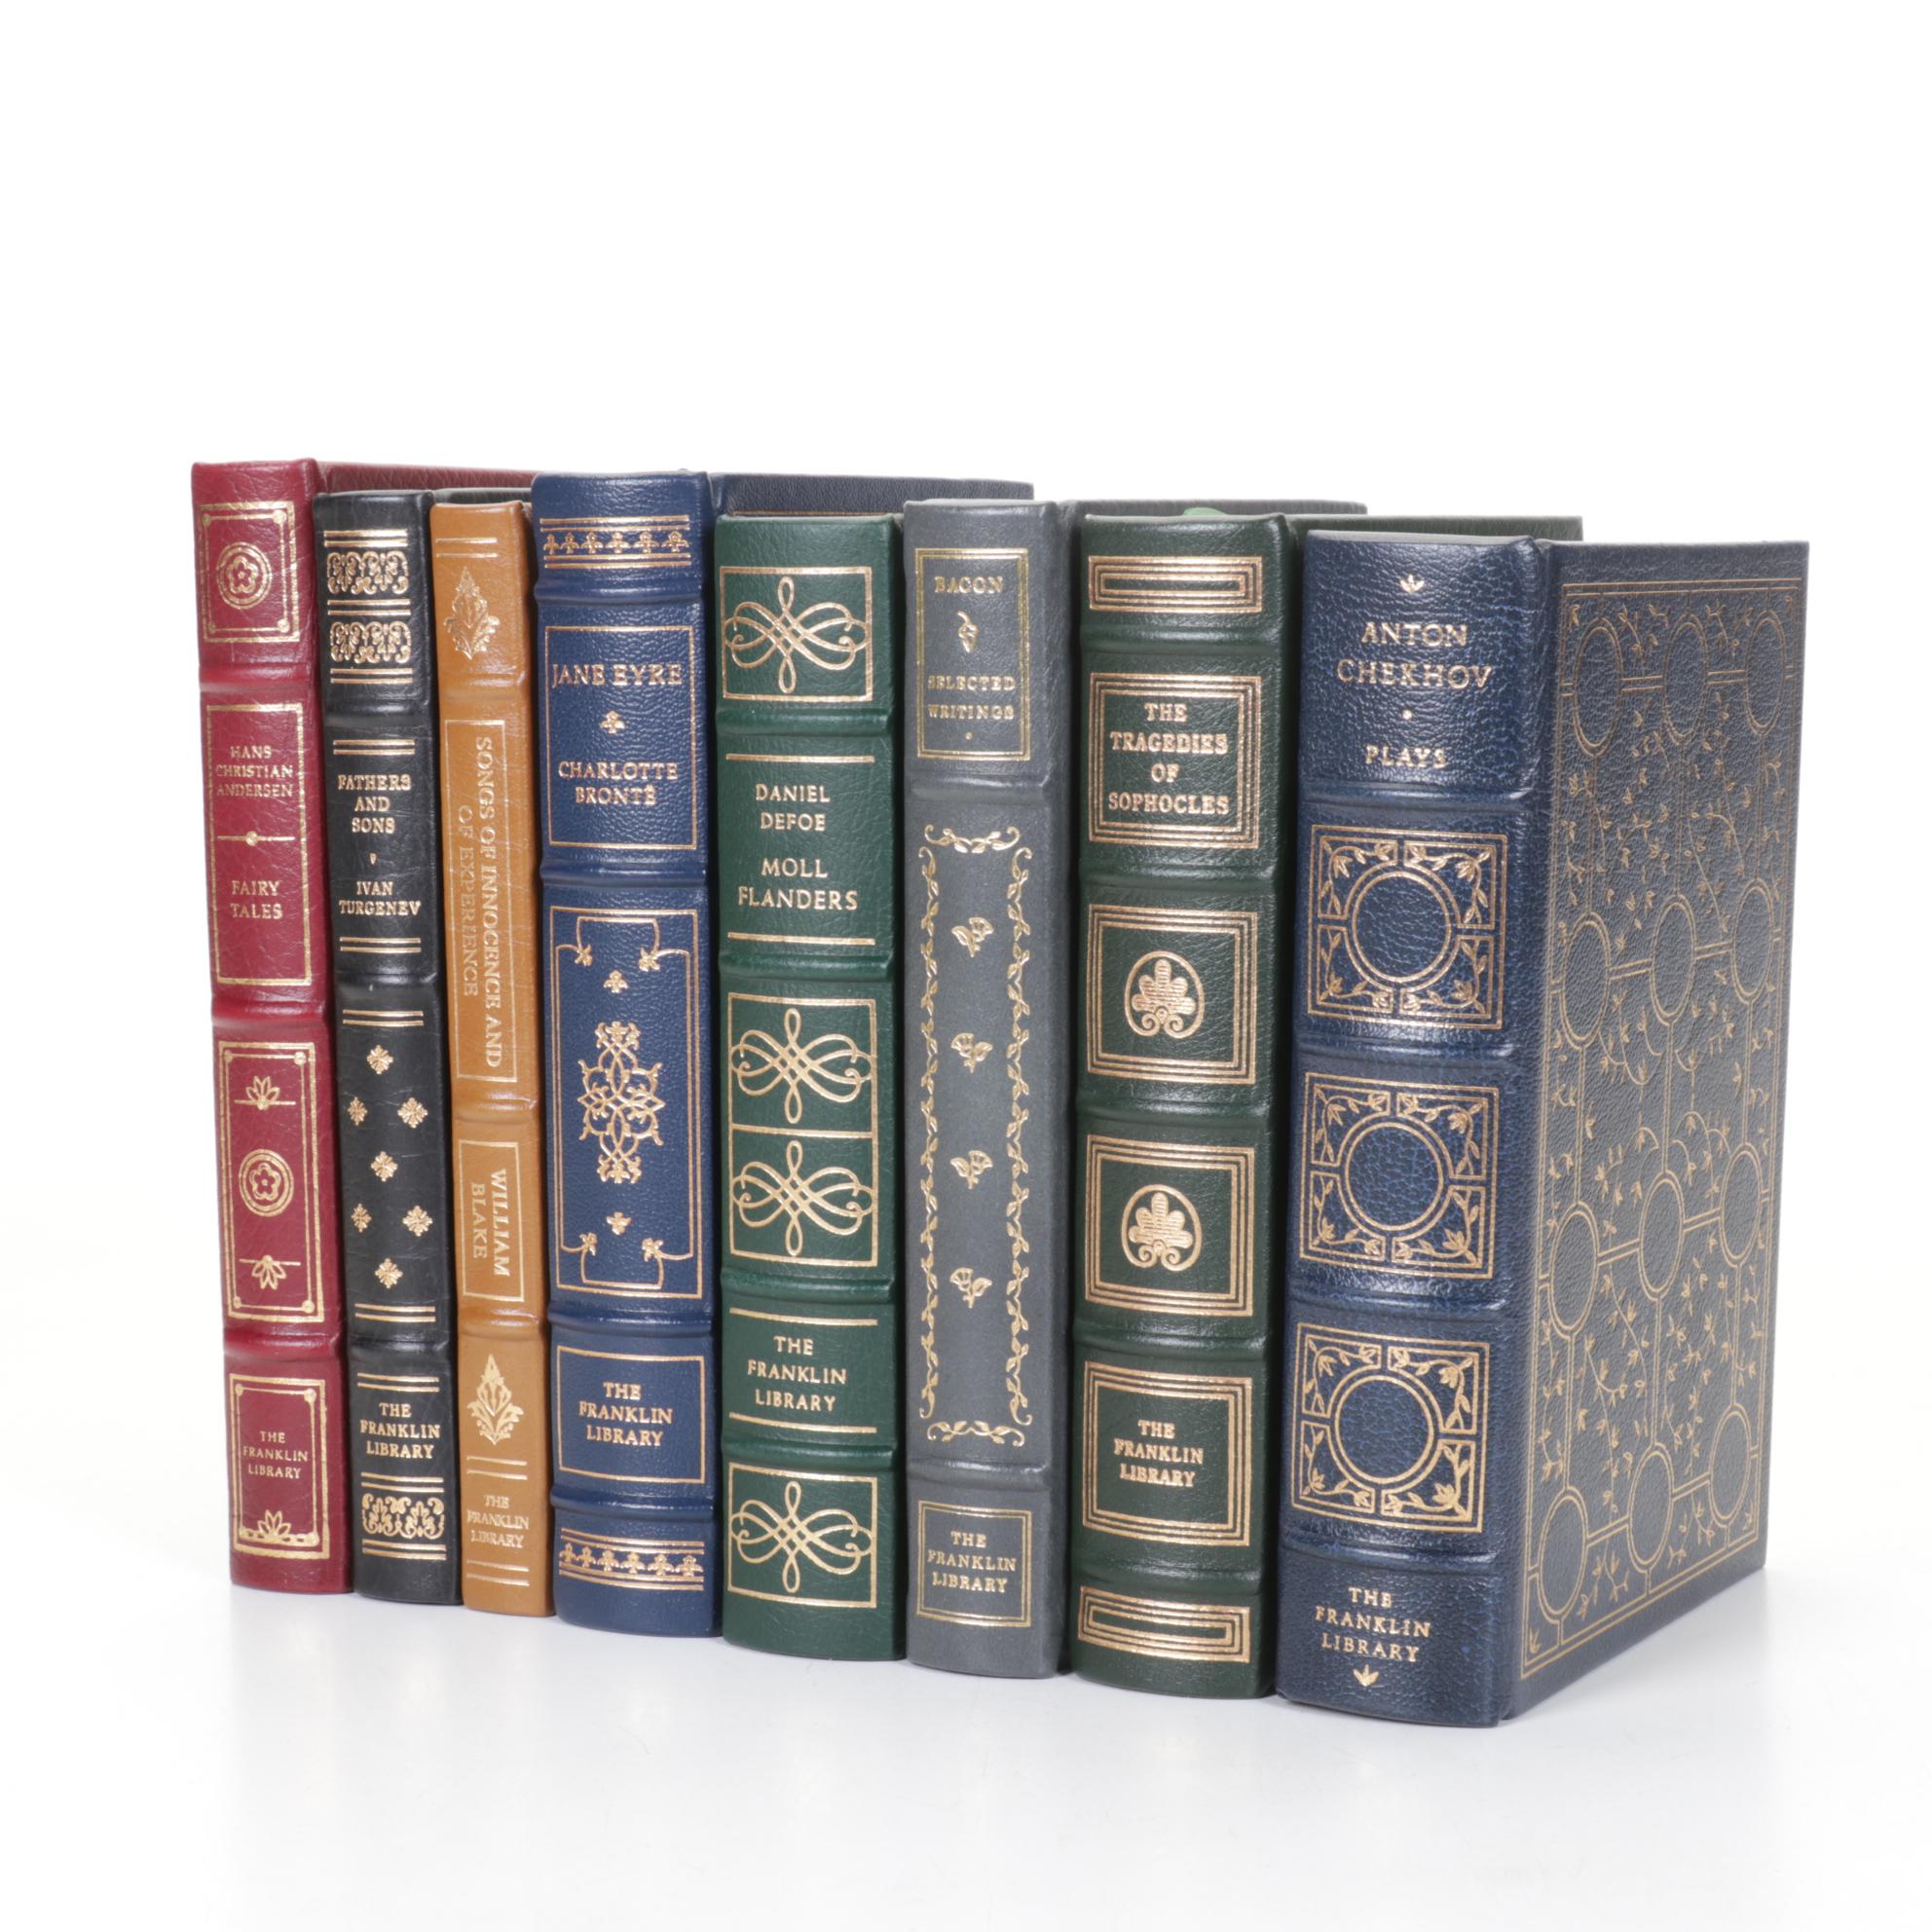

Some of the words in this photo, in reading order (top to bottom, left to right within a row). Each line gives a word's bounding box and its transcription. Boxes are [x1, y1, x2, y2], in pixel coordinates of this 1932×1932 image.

[935, 576, 1003, 594] BACON
[1361, 621, 1468, 648] ANTON
[552, 663, 606, 688] JANE
[613, 664, 683, 687] EYRE
[927, 675, 1017, 691] SELECTED
[1336, 658, 1493, 689] CHEKHOV
[927, 704, 1015, 721] WRITINGS
[1144, 702, 1188, 723] THE
[231, 745, 272, 759] HANS
[1110, 731, 1229, 755] TRAGEDIES
[1365, 744, 1450, 769] PLAYS
[216, 764, 293, 778] CHRISTIAN
[476, 736, 496, 819] SONGS
[558, 761, 679, 780] CHARLOTTE
[1151, 762, 1180, 783] OF
[216, 784, 292, 798] ANDERSEN
[338, 774, 412, 791] FATHERS
[755, 783, 831, 803] DANIEL
[354, 797, 390, 812] AND
[1108, 792, 1230, 815] SOPHOCLES
[352, 817, 395, 834] SONS
[459, 805, 474, 838] OF
[761, 811, 827, 832] DEFOE
[480, 827, 496, 859] OF
[762, 858, 829, 878] MOLL
[232, 880, 280, 896] FAIRY
[356, 880, 394, 896] IVAN
[738, 886, 858, 910] FLANDERS
[230, 904, 282, 920] TALES
[339, 900, 421, 916] TURGENEV
[460, 847, 478, 996] EXPERIENCE
[481, 865, 501, 1009] INNOCENCE
[485, 1016, 502, 1067] AND
[471, 1182, 488, 1258] BLAKE
[491, 1169, 510, 1277] WILLIAM
[773, 1335, 814, 1356] THE
[747, 1358, 847, 1385] FRANKLIN
[603, 1382, 642, 1400] THE
[755, 1388, 836, 1412] LIBRARY
[379, 1402, 412, 1418] THE
[578, 1400, 673, 1425] FRANKLIN
[260, 1430, 286, 1443] THE
[360, 1420, 441, 1438] FRANKLIN
[586, 1425, 663, 1447] LIBRARY
[1137, 1419, 1176, 1440] THE
[243, 1446, 309, 1462] FRANKLIN
[366, 1440, 434, 1459] LIBRARY
[1114, 1437, 1204, 1465] FRANKLIN
[248, 1465, 301, 1479] LIBRARY
[1119, 1463, 1196, 1488] LIBRARY
[484, 1495, 509, 1509] THE
[467, 1509, 529, 1530] FRANKLIN
[470, 1529, 524, 1548] LIBRARY
[950, 1530, 987, 1548] THE
[927, 1549, 1017, 1572] FRANKLIN
[932, 1571, 1008, 1594] LIBRARY
[1348, 1586, 1393, 1608] THE
[1315, 1605, 1431, 1638] FRANKLIN
[1321, 1632, 1420, 1662] LIBRARY
